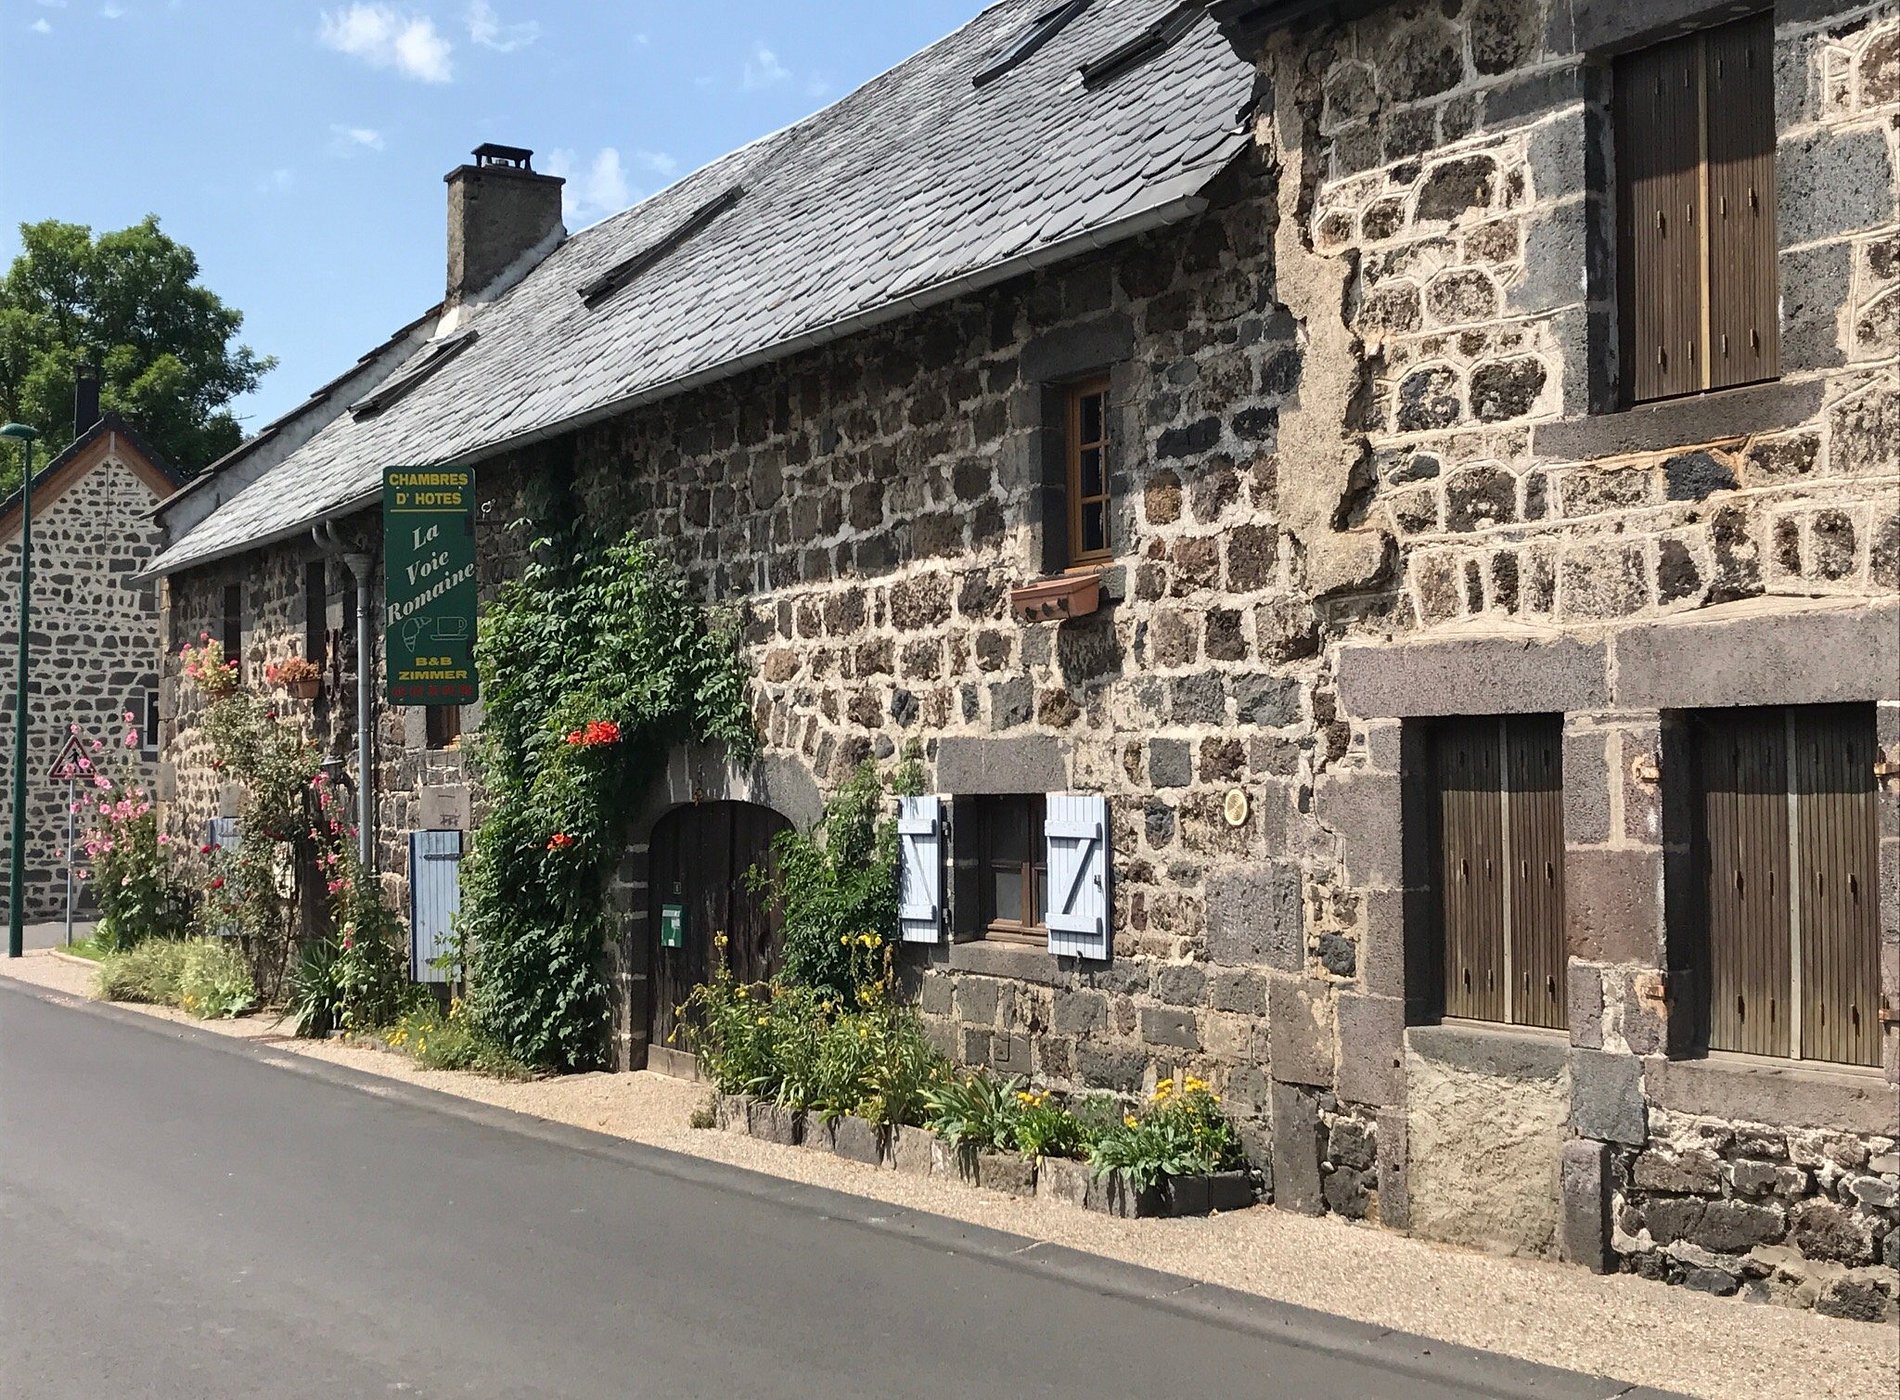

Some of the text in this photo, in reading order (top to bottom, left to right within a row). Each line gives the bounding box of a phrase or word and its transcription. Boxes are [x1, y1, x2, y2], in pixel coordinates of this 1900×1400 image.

[389, 473, 468, 486] CHAMBRES
[396, 492, 462, 505] D' HOTES
[412, 524, 439, 551] La
[406, 551, 449, 585] Voie
[387, 563, 475, 628] Romaine
[415, 656, 452, 666] B&B
[398, 670, 468, 680] ZIMMER
